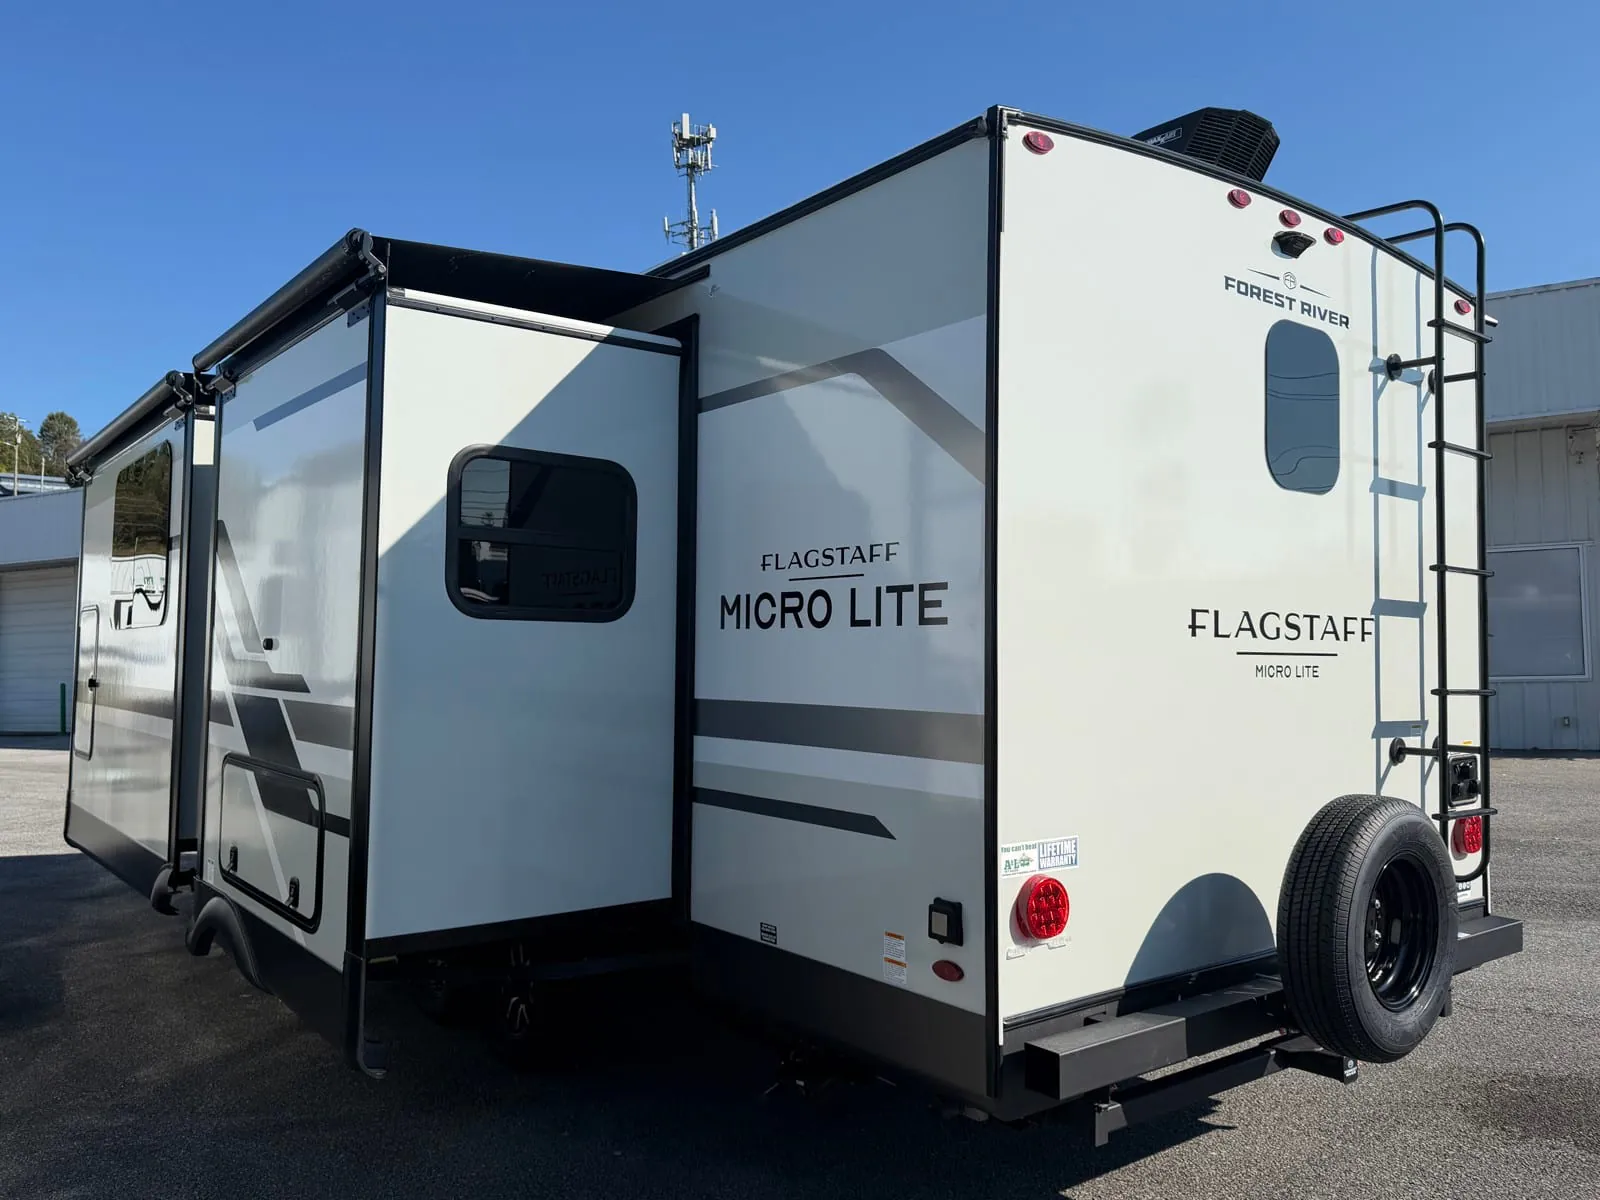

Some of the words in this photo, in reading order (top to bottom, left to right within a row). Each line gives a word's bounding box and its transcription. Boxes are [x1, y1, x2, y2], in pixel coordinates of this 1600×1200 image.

[1224, 275, 1297, 311] FOREST
[1300, 300, 1350, 329] RIVER
[761, 542, 900, 571] FLAGSTAFF
[720, 589, 833, 630] MICRO
[850, 582, 949, 627] LITE
[1188, 608, 1375, 642] FLAGSTAFF
[1255, 665, 1292, 678] MICRO
[1295, 665, 1320, 678] LITE
[1040, 839, 1077, 858] LIFETIME
[1040, 853, 1077, 868] WARRANTY
